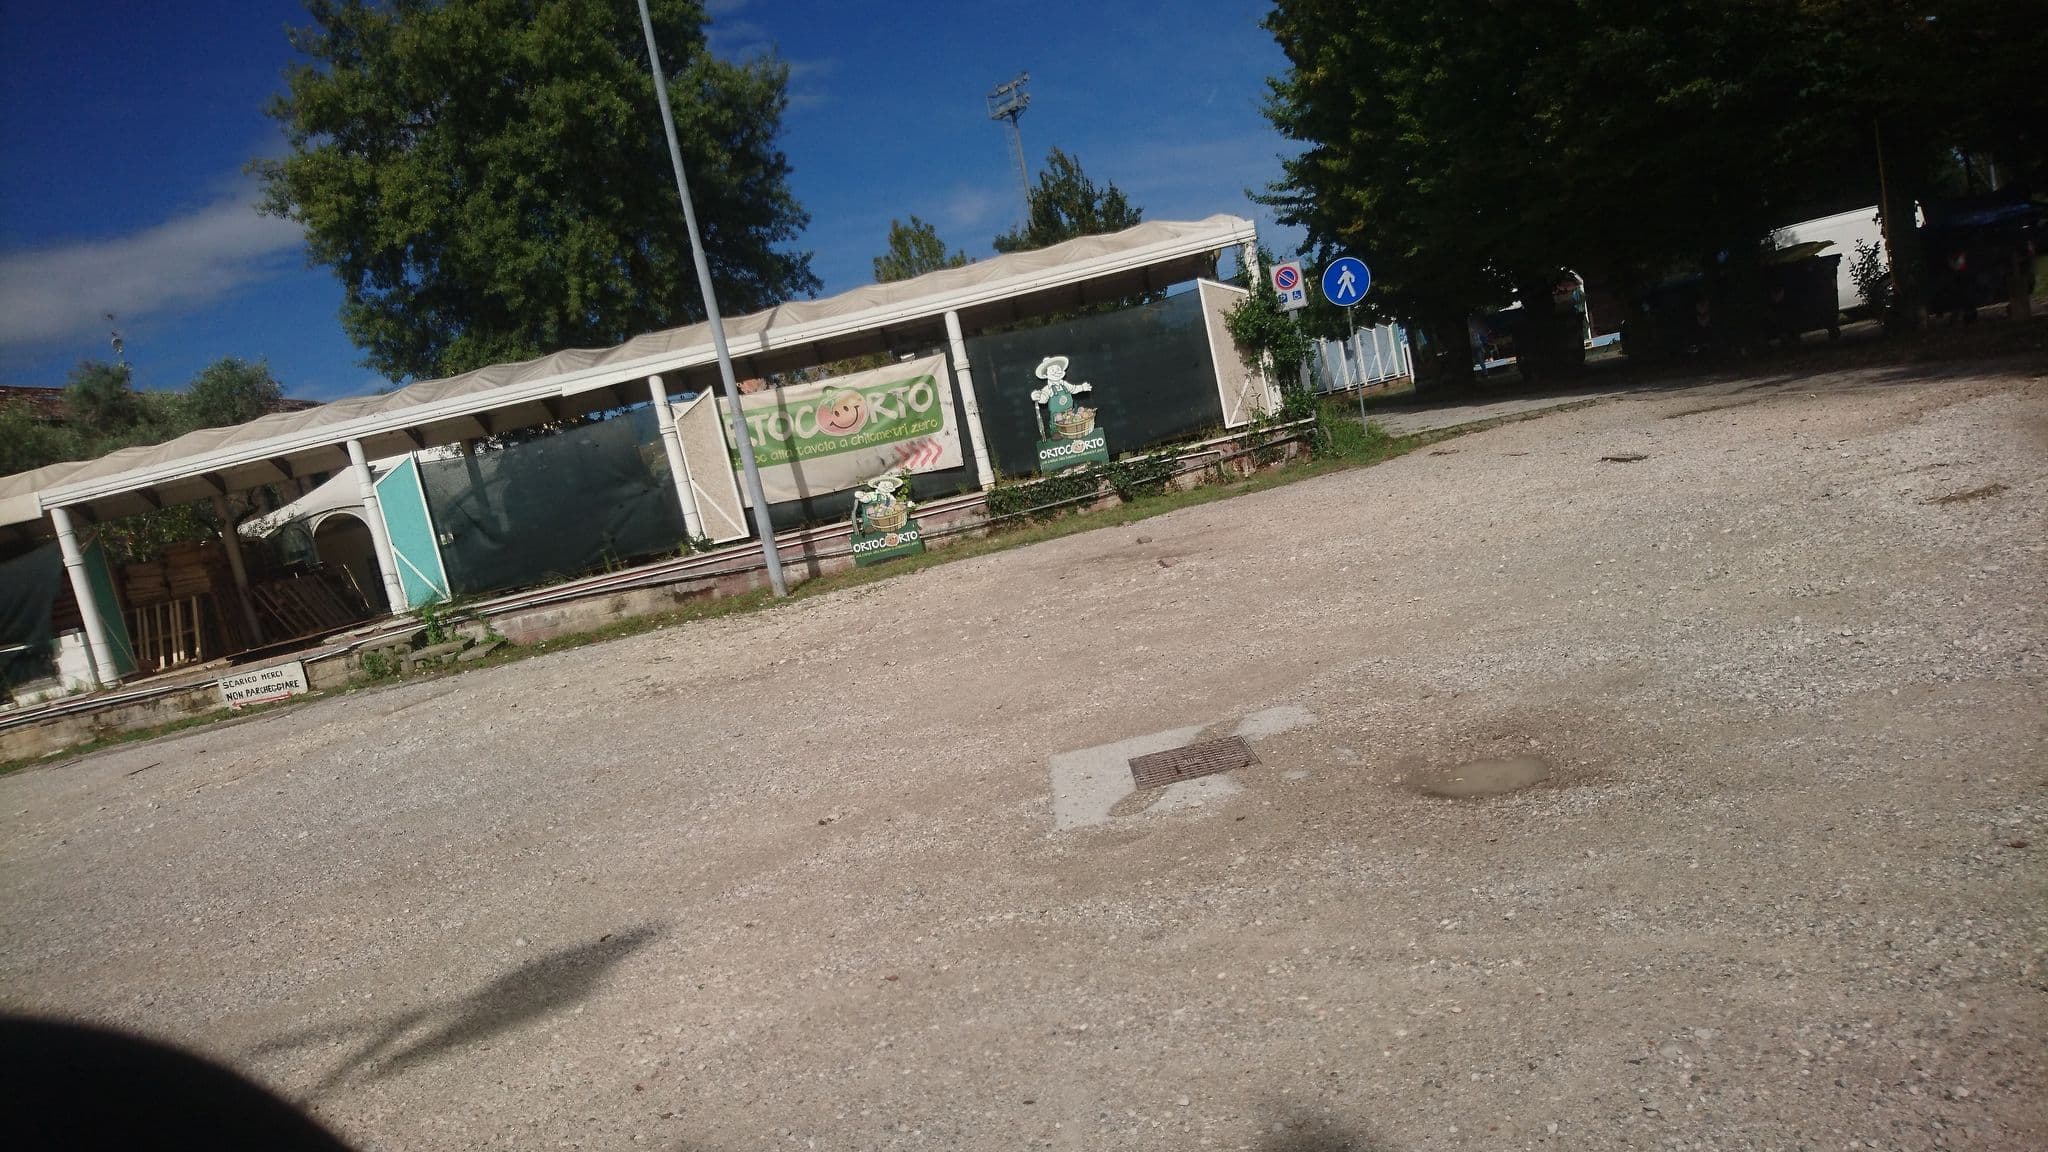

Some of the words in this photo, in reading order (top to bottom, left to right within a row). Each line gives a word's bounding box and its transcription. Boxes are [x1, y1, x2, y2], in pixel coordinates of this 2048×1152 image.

[795, 440, 836, 455] tavola
[839, 438, 849, 448] a
[910, 418, 938, 433] zero
[222, 675, 257, 689] SCARICO
[261, 670, 283, 681] MERCI
[226, 691, 244, 701] NON
[246, 679, 299, 697] PARCHEGGIARE
